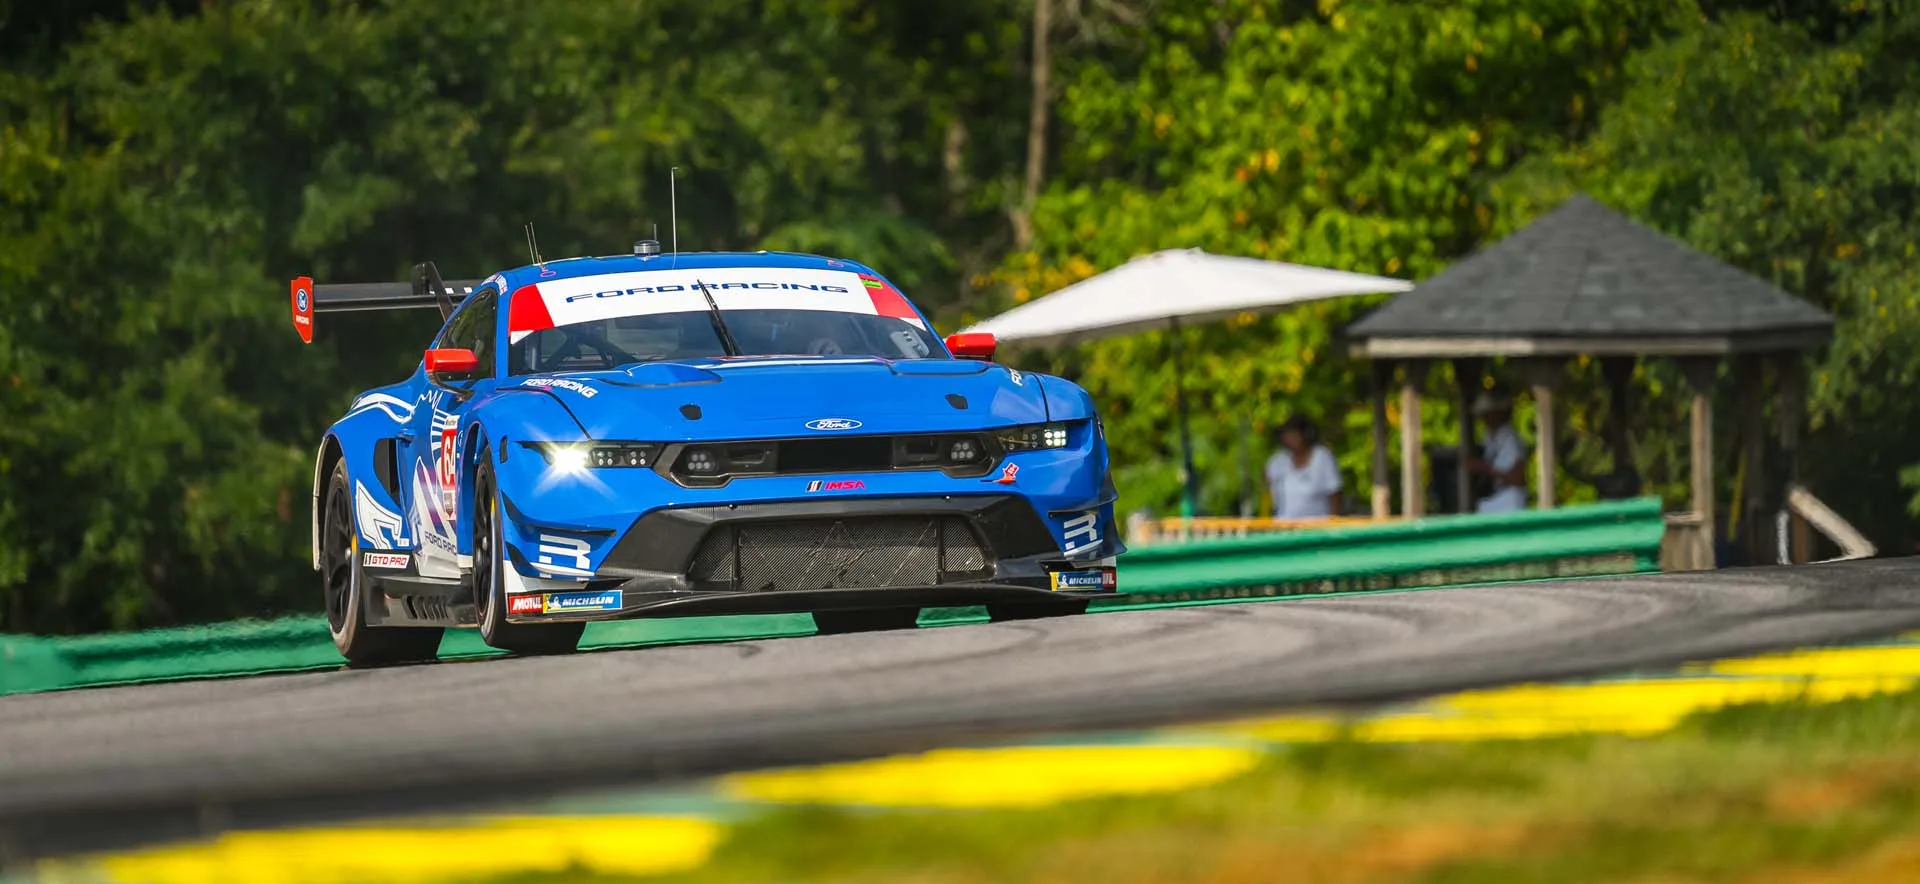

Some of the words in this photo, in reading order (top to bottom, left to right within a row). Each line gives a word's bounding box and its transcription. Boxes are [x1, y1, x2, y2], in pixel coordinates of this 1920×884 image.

[566, 285, 685, 303] FORD
[690, 282, 849, 294] RACING
[519, 378, 552, 387] FORD
[549, 378, 599, 398] RACING
[444, 435, 457, 485] 64
[824, 480, 866, 491] IMSA
[424, 531, 443, 549] FORD
[442, 540, 457, 556] RAC
[389, 556, 408, 566] PRO
[1068, 577, 1102, 585] MICHELIN
[512, 597, 542, 611] MOTUL
[562, 596, 614, 606] MICHELIN
